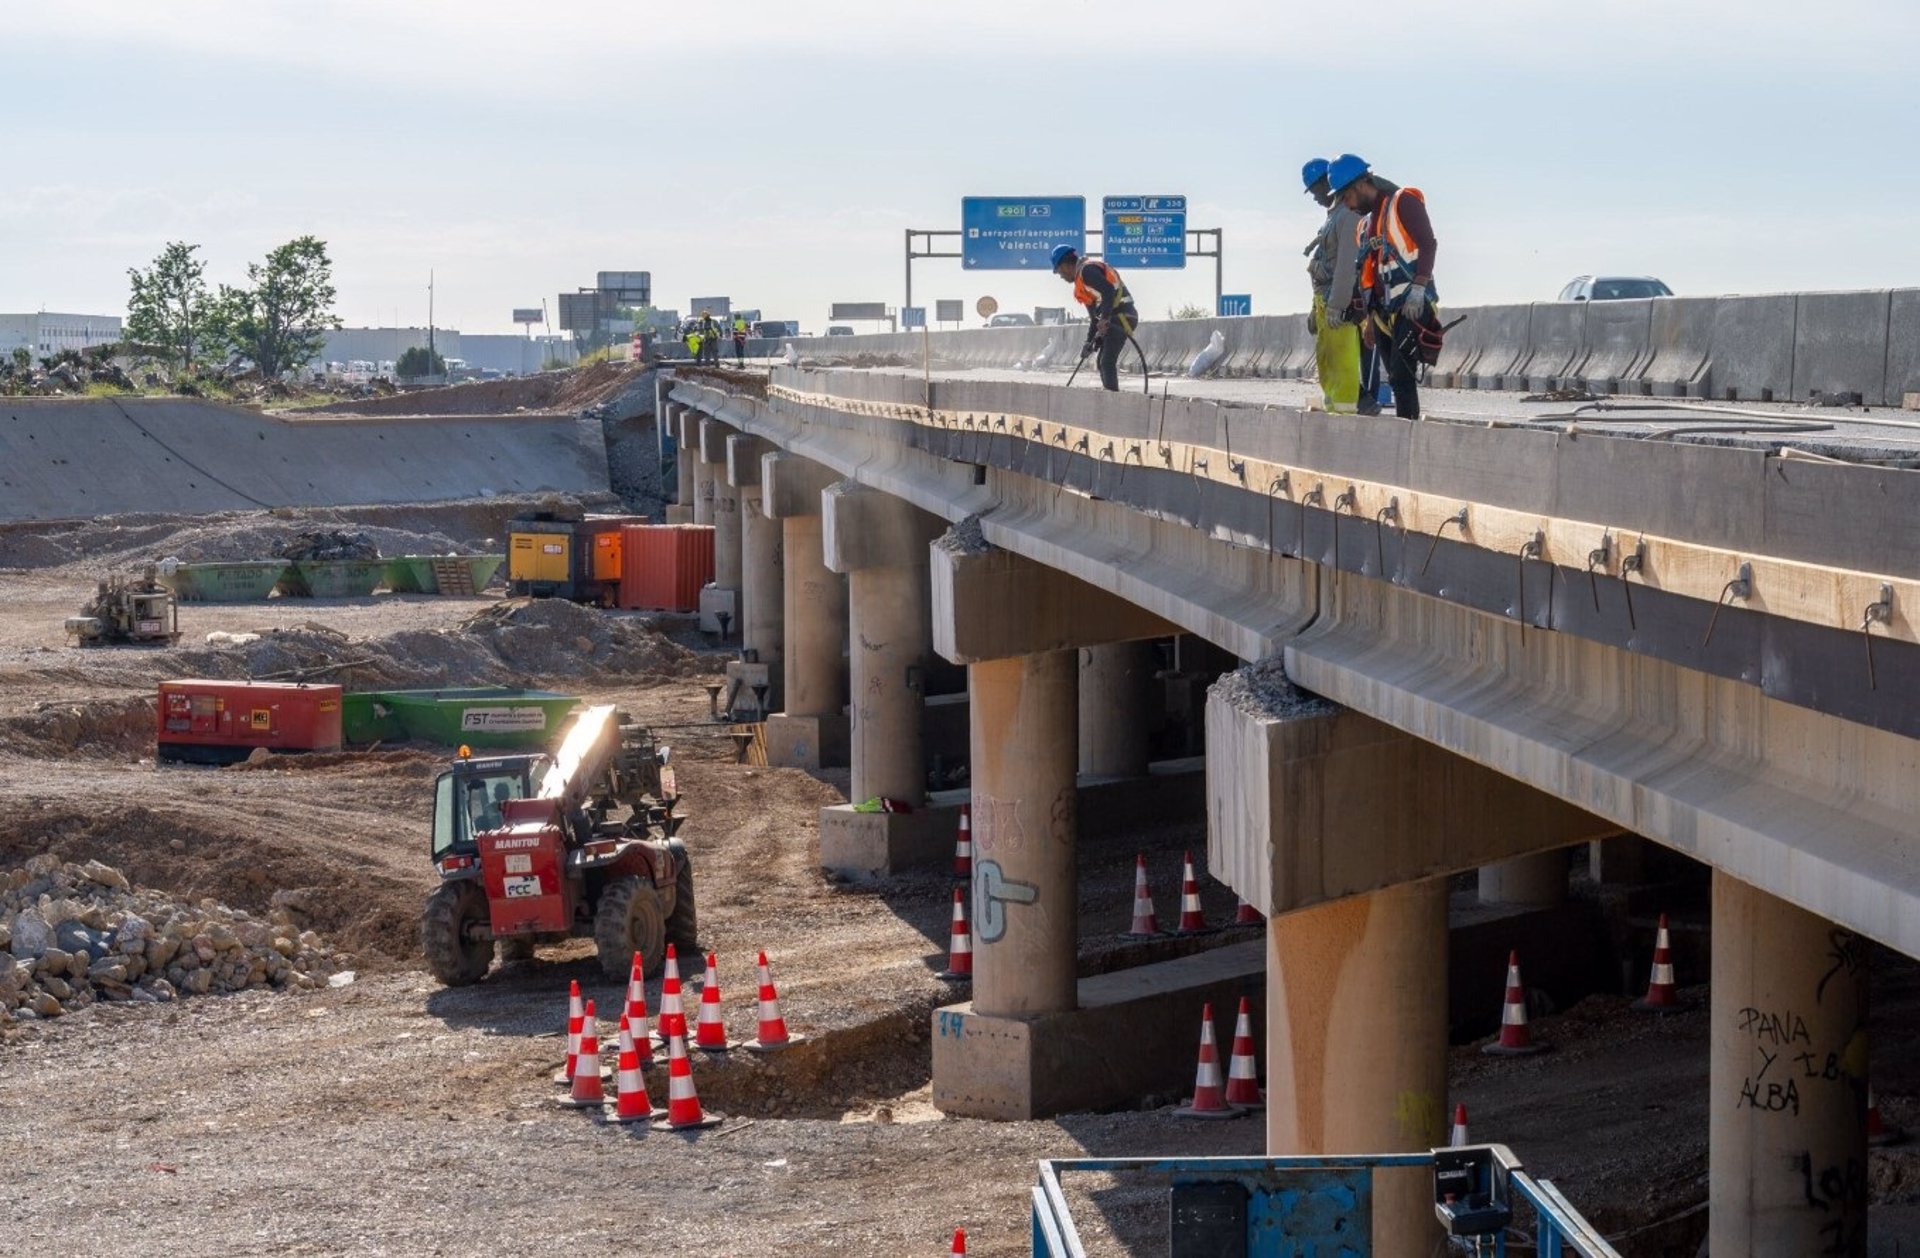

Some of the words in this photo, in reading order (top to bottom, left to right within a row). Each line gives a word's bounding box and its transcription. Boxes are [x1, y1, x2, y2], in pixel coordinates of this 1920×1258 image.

[999, 241, 1050, 250] Valencia
[465, 713, 489, 725] FST
[495, 838, 540, 849] MANITOU
[508, 884, 531, 895] FCC
[1738, 1007, 1811, 1045] PANA
[1757, 1047, 1777, 1079] Y
